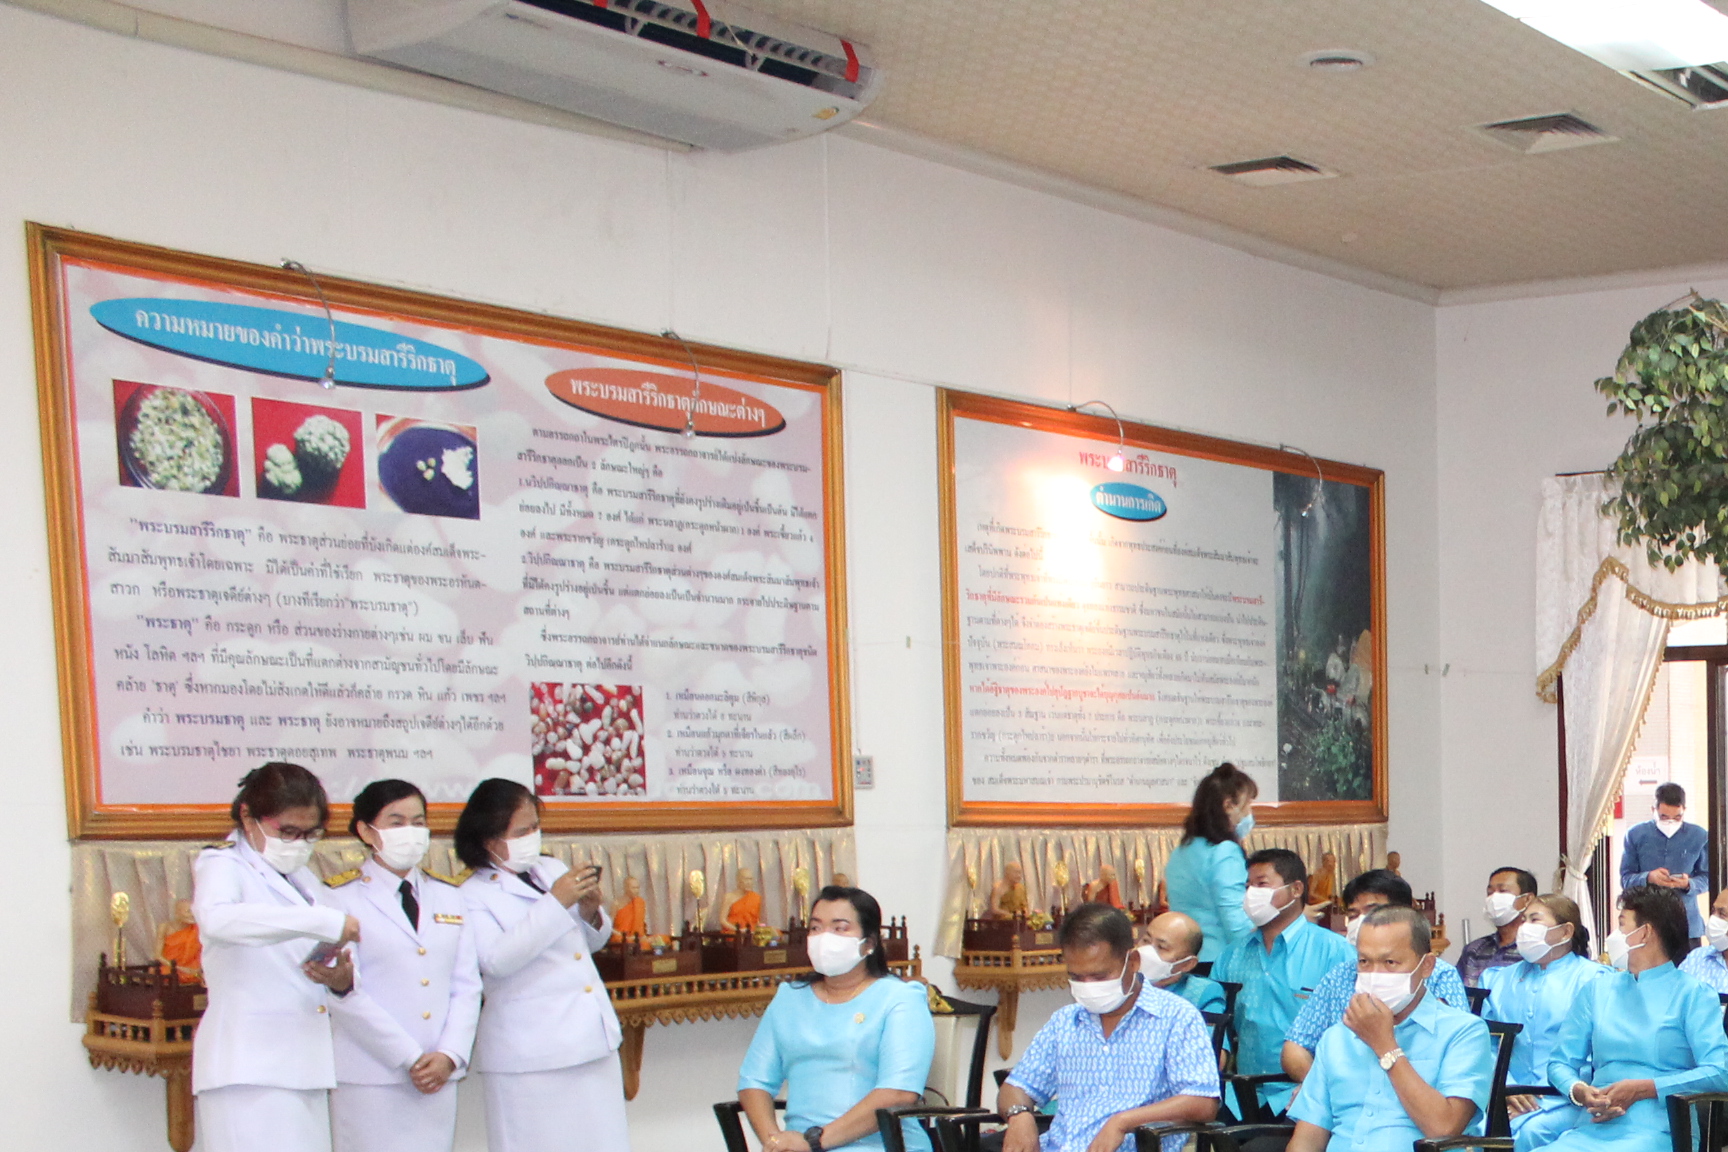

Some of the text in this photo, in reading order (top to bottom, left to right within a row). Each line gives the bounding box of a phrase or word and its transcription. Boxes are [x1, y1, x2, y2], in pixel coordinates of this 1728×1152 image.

[135, 310, 457, 386] ความหมายของคำว่าพระบรมสารีริกธาตุ
[652, 464, 663, 478] คือ
[1079, 452, 1177, 488] พระบสารีริกธาตุ
[592, 481, 603, 495] คือ
[1095, 485, 1161, 513] ตำนานการเกิด
[258, 525, 273, 543] คือ
[589, 556, 599, 569] คือ
[110, 583, 140, 595] สาวก
[523, 600, 570, 620] สถานที่ต่างๆ
[205, 614, 220, 631] คือ
[226, 622, 262, 638] กระดูก
[267, 618, 289, 635] หรือ
[418, 633, 433, 643] ผม
[437, 634, 452, 644] ขน
[456, 629, 474, 645] เล็บ
[114, 643, 139, 660] หนัง
[143, 643, 176, 661] โลหิต
[182, 652, 205, 662] ฯลฯ
[116, 675, 146, 692] คล้าย
[387, 690, 413, 700] กรวด
[417, 686, 433, 701] หิน
[437, 686, 457, 702] แก้ว
[462, 693, 484, 703] เพชร
[142, 707, 170, 724] คำว่า
[175, 713, 245, 731] พระบรมธาตุ
[250, 715, 271, 726] และ
[278, 716, 321, 733] พระธาตุ
[121, 740, 143, 756] เช่น
[149, 740, 241, 761] พระบรมธาตุไชยา
[246, 747, 337, 761] พระธาตุดอยสุเทพ
[347, 748, 408, 762] พระธาตุพนม
